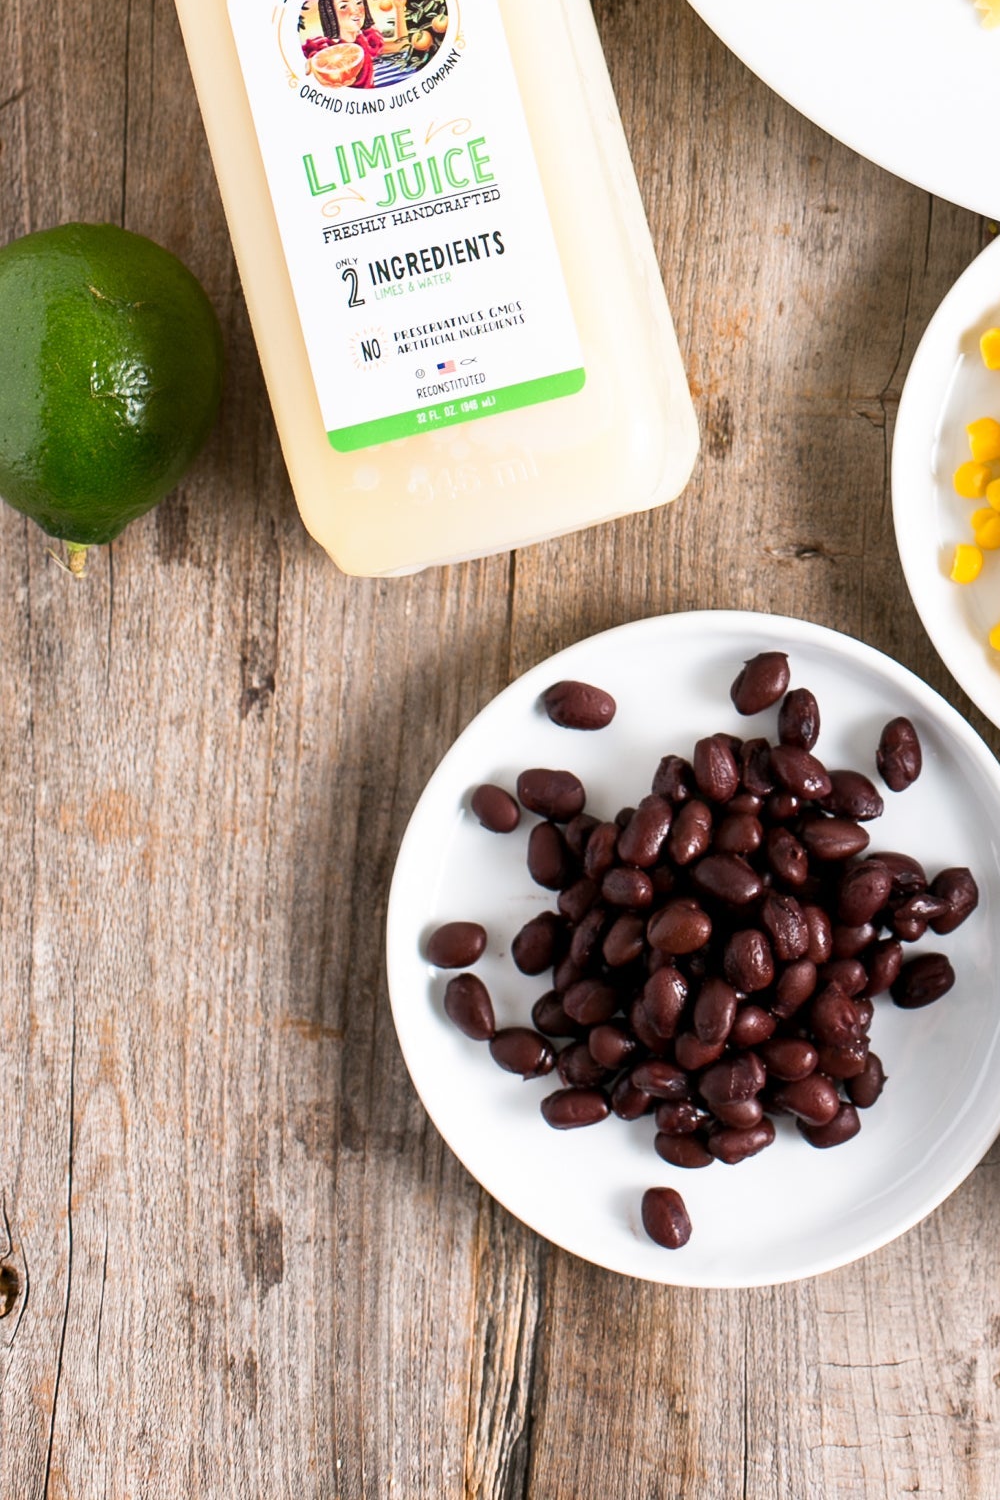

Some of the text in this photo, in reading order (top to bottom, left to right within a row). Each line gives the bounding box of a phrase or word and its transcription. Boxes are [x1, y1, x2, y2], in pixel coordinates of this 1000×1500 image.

[300, 48, 462, 115] ORCHID ISLAND JUICE COMPANY
[302, 128, 416, 197] LIME
[376, 136, 495, 207] JUICE
[322, 188, 501, 244] FRESHLY HANDCRAFTED
[335, 257, 358, 270] ONLY
[341, 230, 505, 308] 2 INGREDIENTS
[374, 271, 452, 301] LIMES & WATER
[361, 338, 382, 362] NO
[397, 313, 525, 355] ARTIFICIAL INGREDIENTS
[416, 372, 486, 399] RECONSTITUTED
